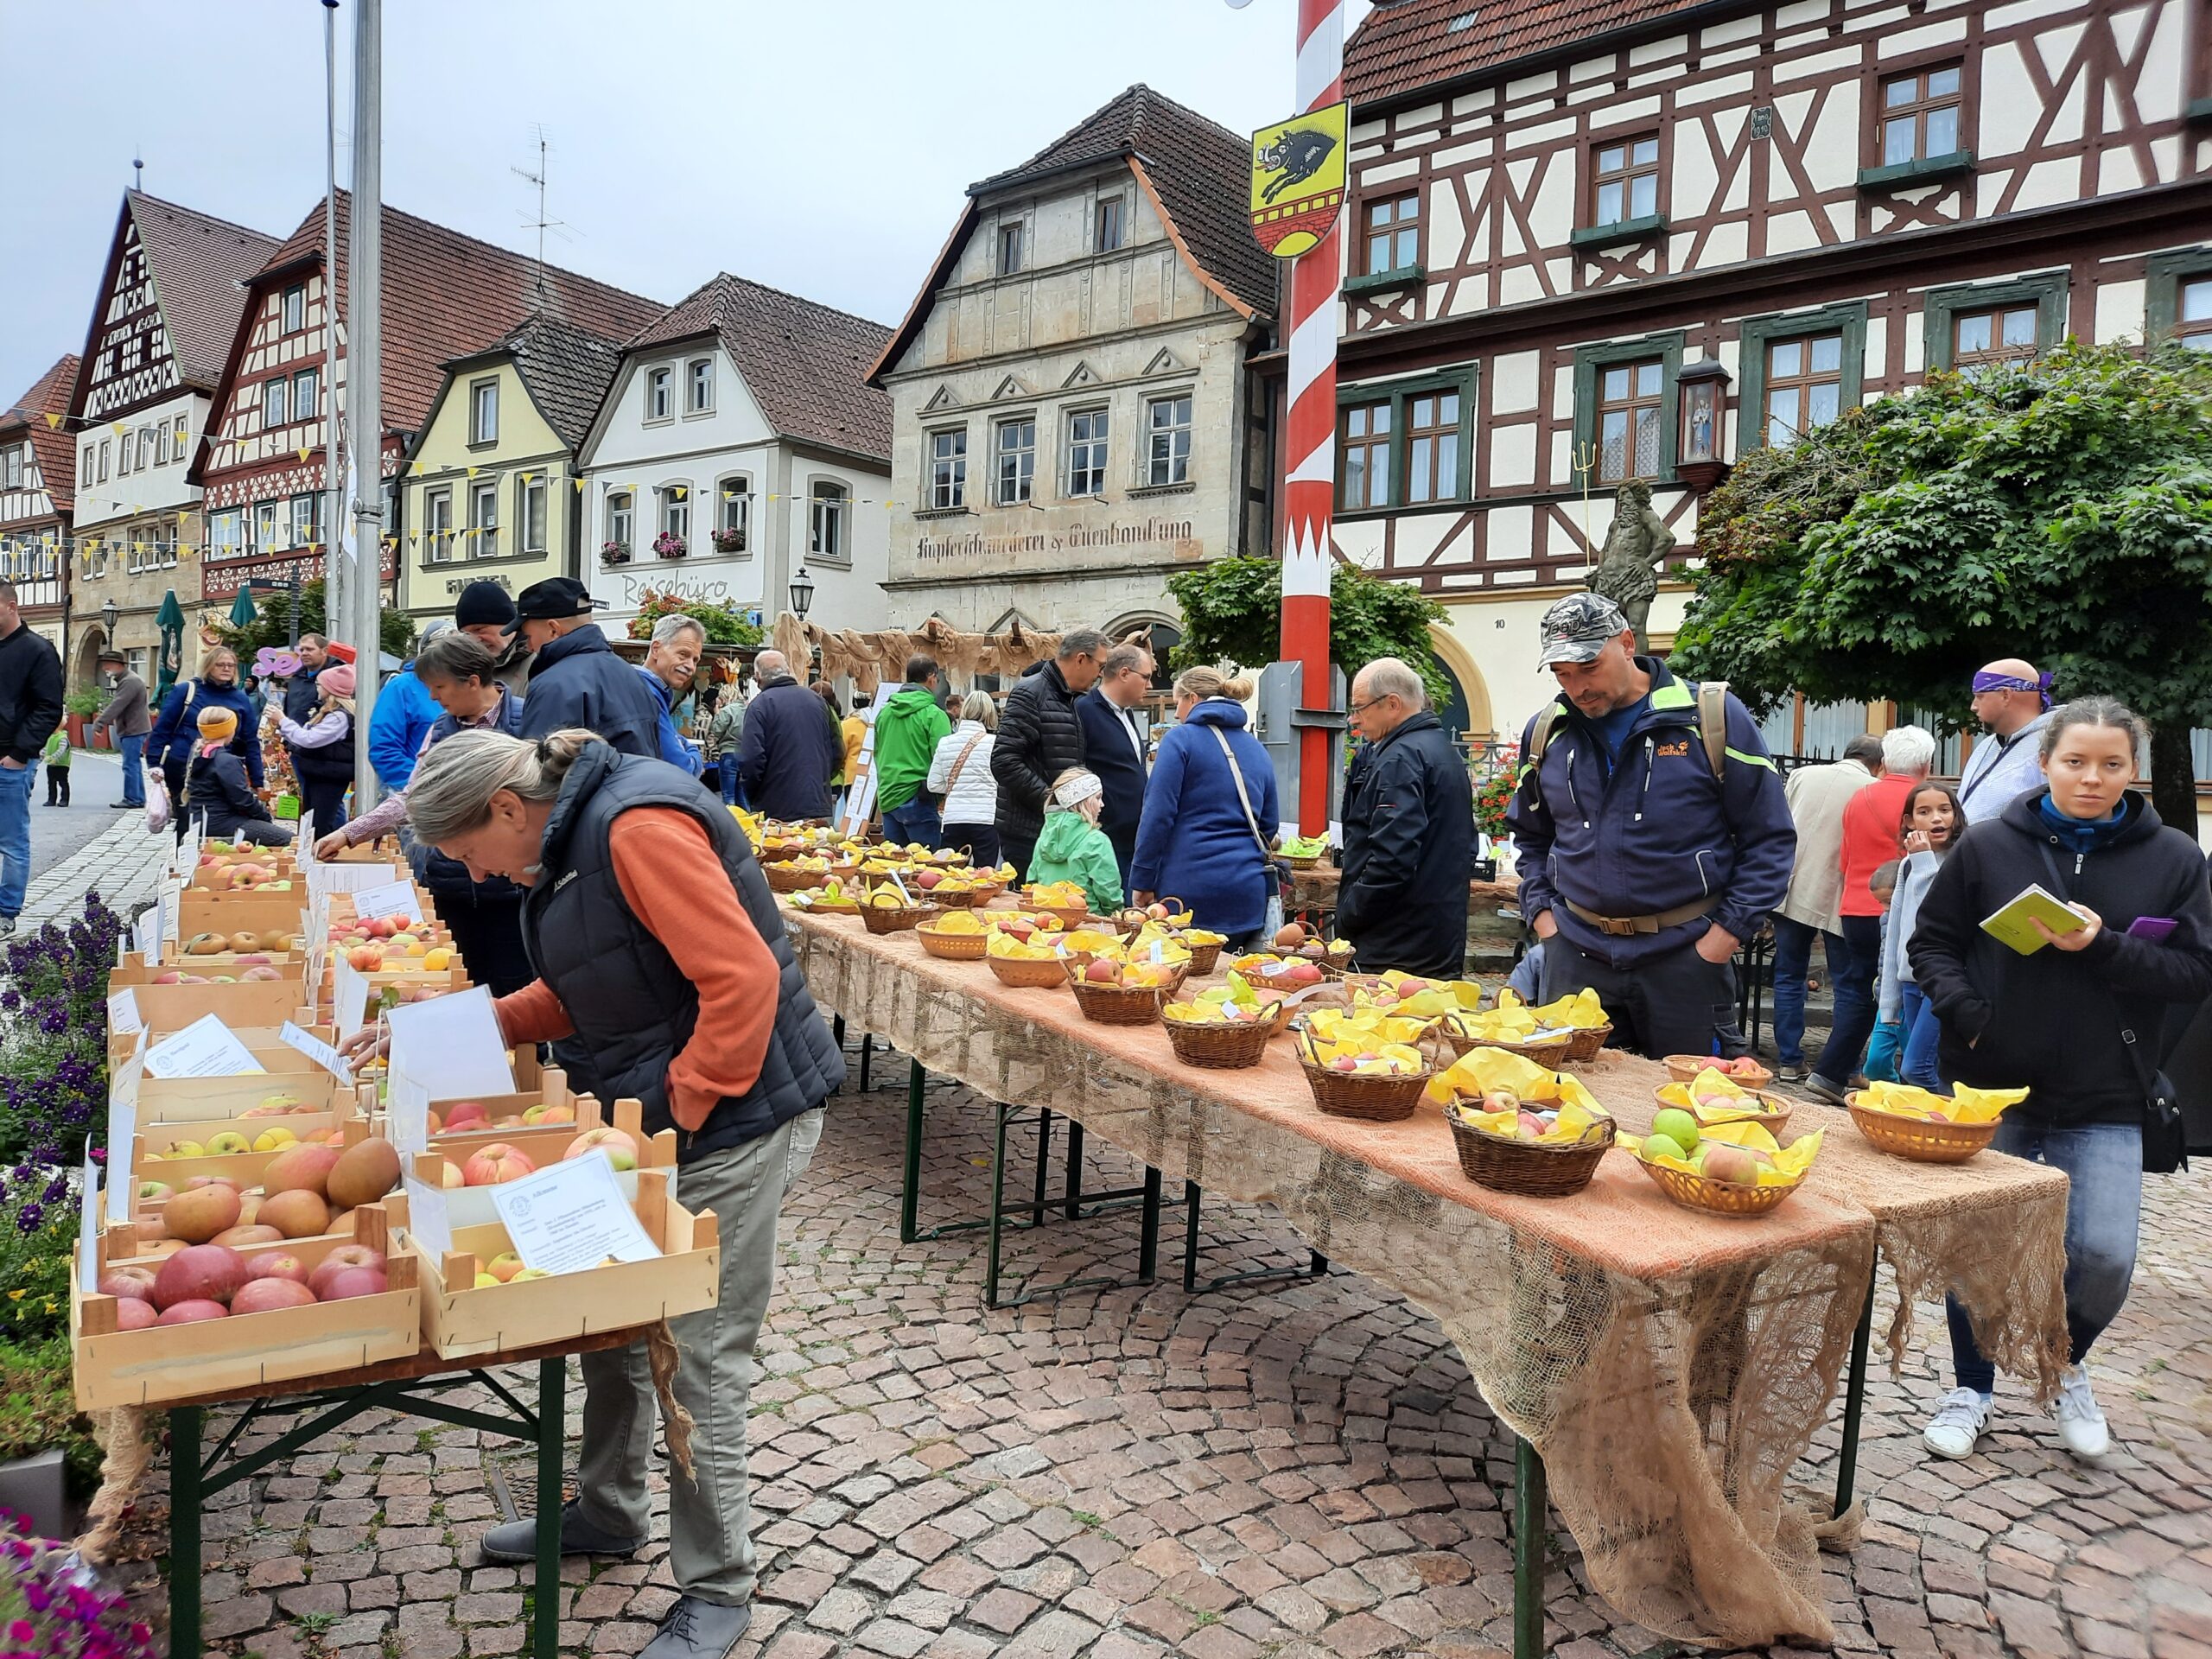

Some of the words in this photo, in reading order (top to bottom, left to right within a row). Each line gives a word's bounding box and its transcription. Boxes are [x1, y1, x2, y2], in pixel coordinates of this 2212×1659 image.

[1051, 537, 1064, 553] &
[621, 569, 728, 607] Reisebüro
[1494, 619, 1505, 629] 10
[1544, 620, 1580, 638] Jeep
[251, 646, 302, 677] Se
